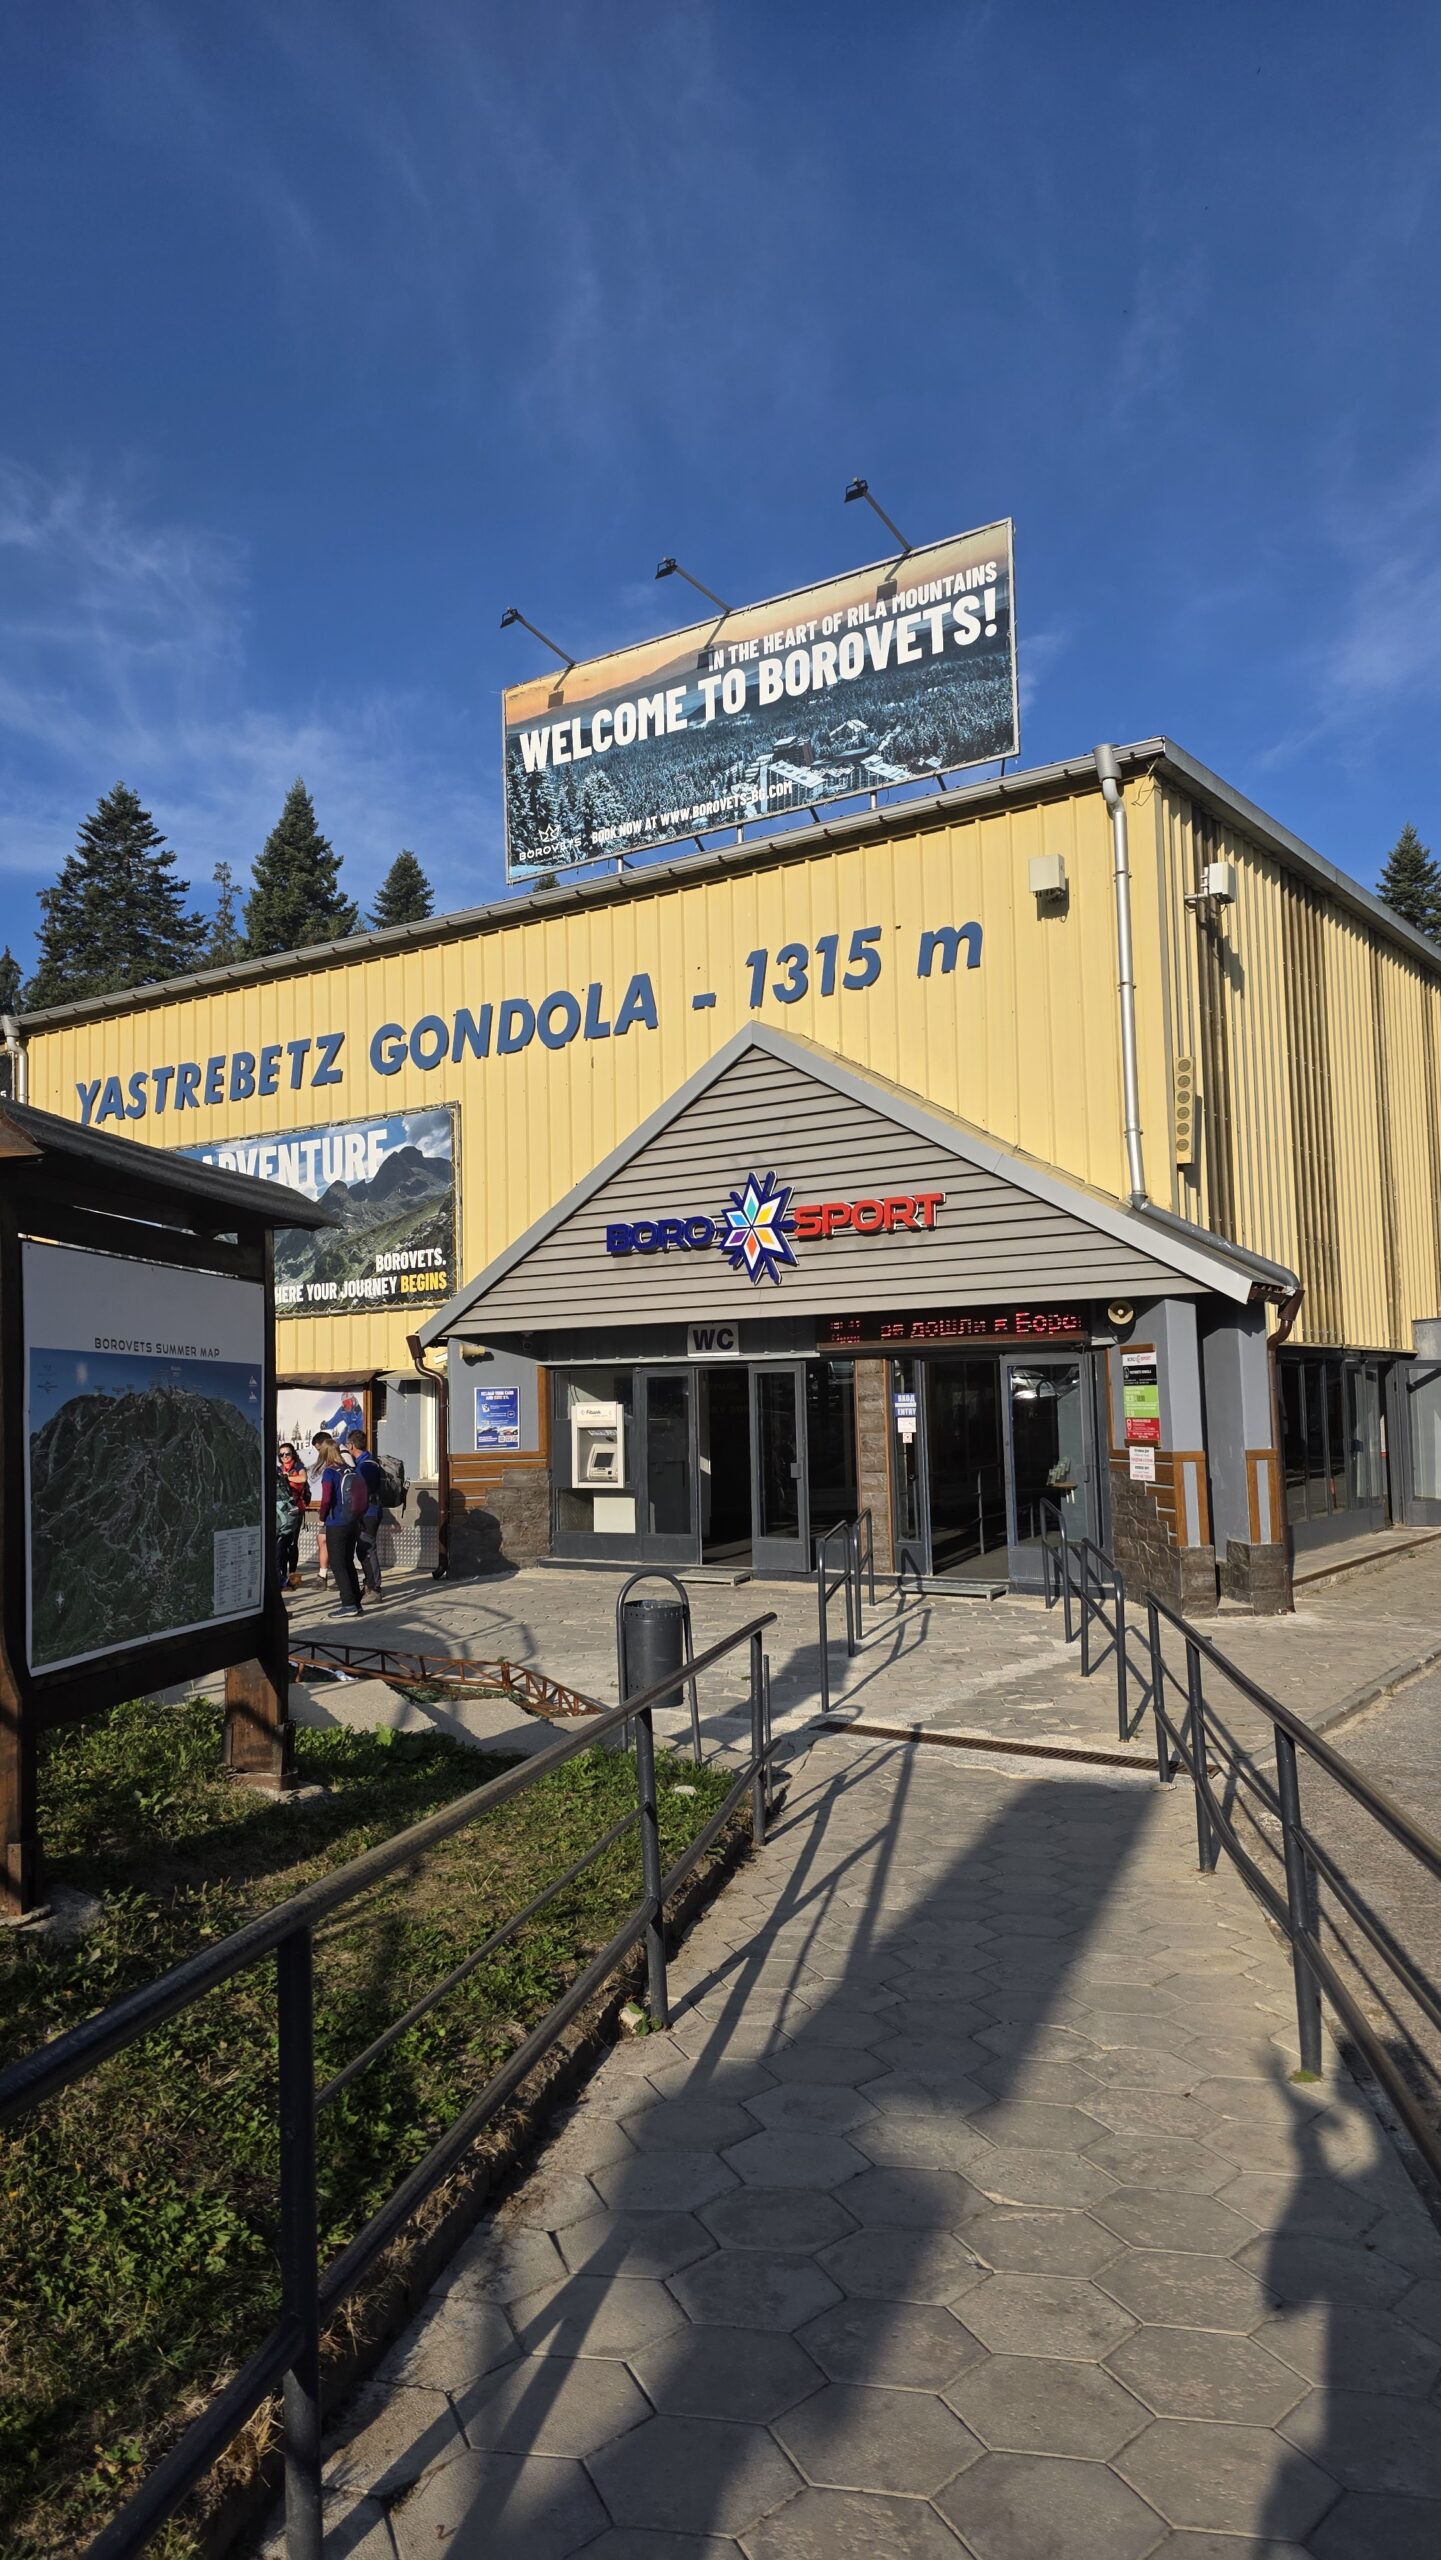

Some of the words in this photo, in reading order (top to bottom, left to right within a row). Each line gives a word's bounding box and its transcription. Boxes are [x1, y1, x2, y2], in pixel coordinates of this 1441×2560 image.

[708, 649, 725, 672] IN
[728, 638, 760, 664] THE
[763, 618, 819, 655] HEART
[821, 612, 843, 636] OF
[847, 597, 888, 628] RILA
[892, 561, 998, 615] MOUNTAINS
[519, 684, 689, 774] WELCOME
[698, 668, 746, 722] TO
[758, 586, 998, 706] BOROVETS!
[591, 827, 617, 845] BOOK
[619, 821, 643, 838] NOW
[645, 815, 658, 830] AT
[660, 779, 793, 826] WWW.BOROVETS-BG.COM
[519, 837, 582, 861] BOROVETS
[75, 1032, 345, 1126] YASTREBETZ
[369, 972, 659, 1077] GONDOLA
[692, 992, 717, 1010] -
[744, 926, 884, 1010] 1315
[916, 920, 984, 979] m
[202, 1128, 388, 1188] VENTURE
[606, 1215, 715, 1255] BORO
[793, 1192, 946, 1240] SPORT
[306, 1281, 337, 1301] YOUR
[340, 1276, 397, 1298] JOURNEY
[400, 1272, 447, 1293] BEGINS
[375, 1248, 447, 1273] BOROVETS.
[94, 1338, 153, 1353] BOROVETS
[155, 1343, 197, 1357] SUMMER
[199, 1347, 220, 1359] MAP
[692, 1327, 735, 1351] WC
